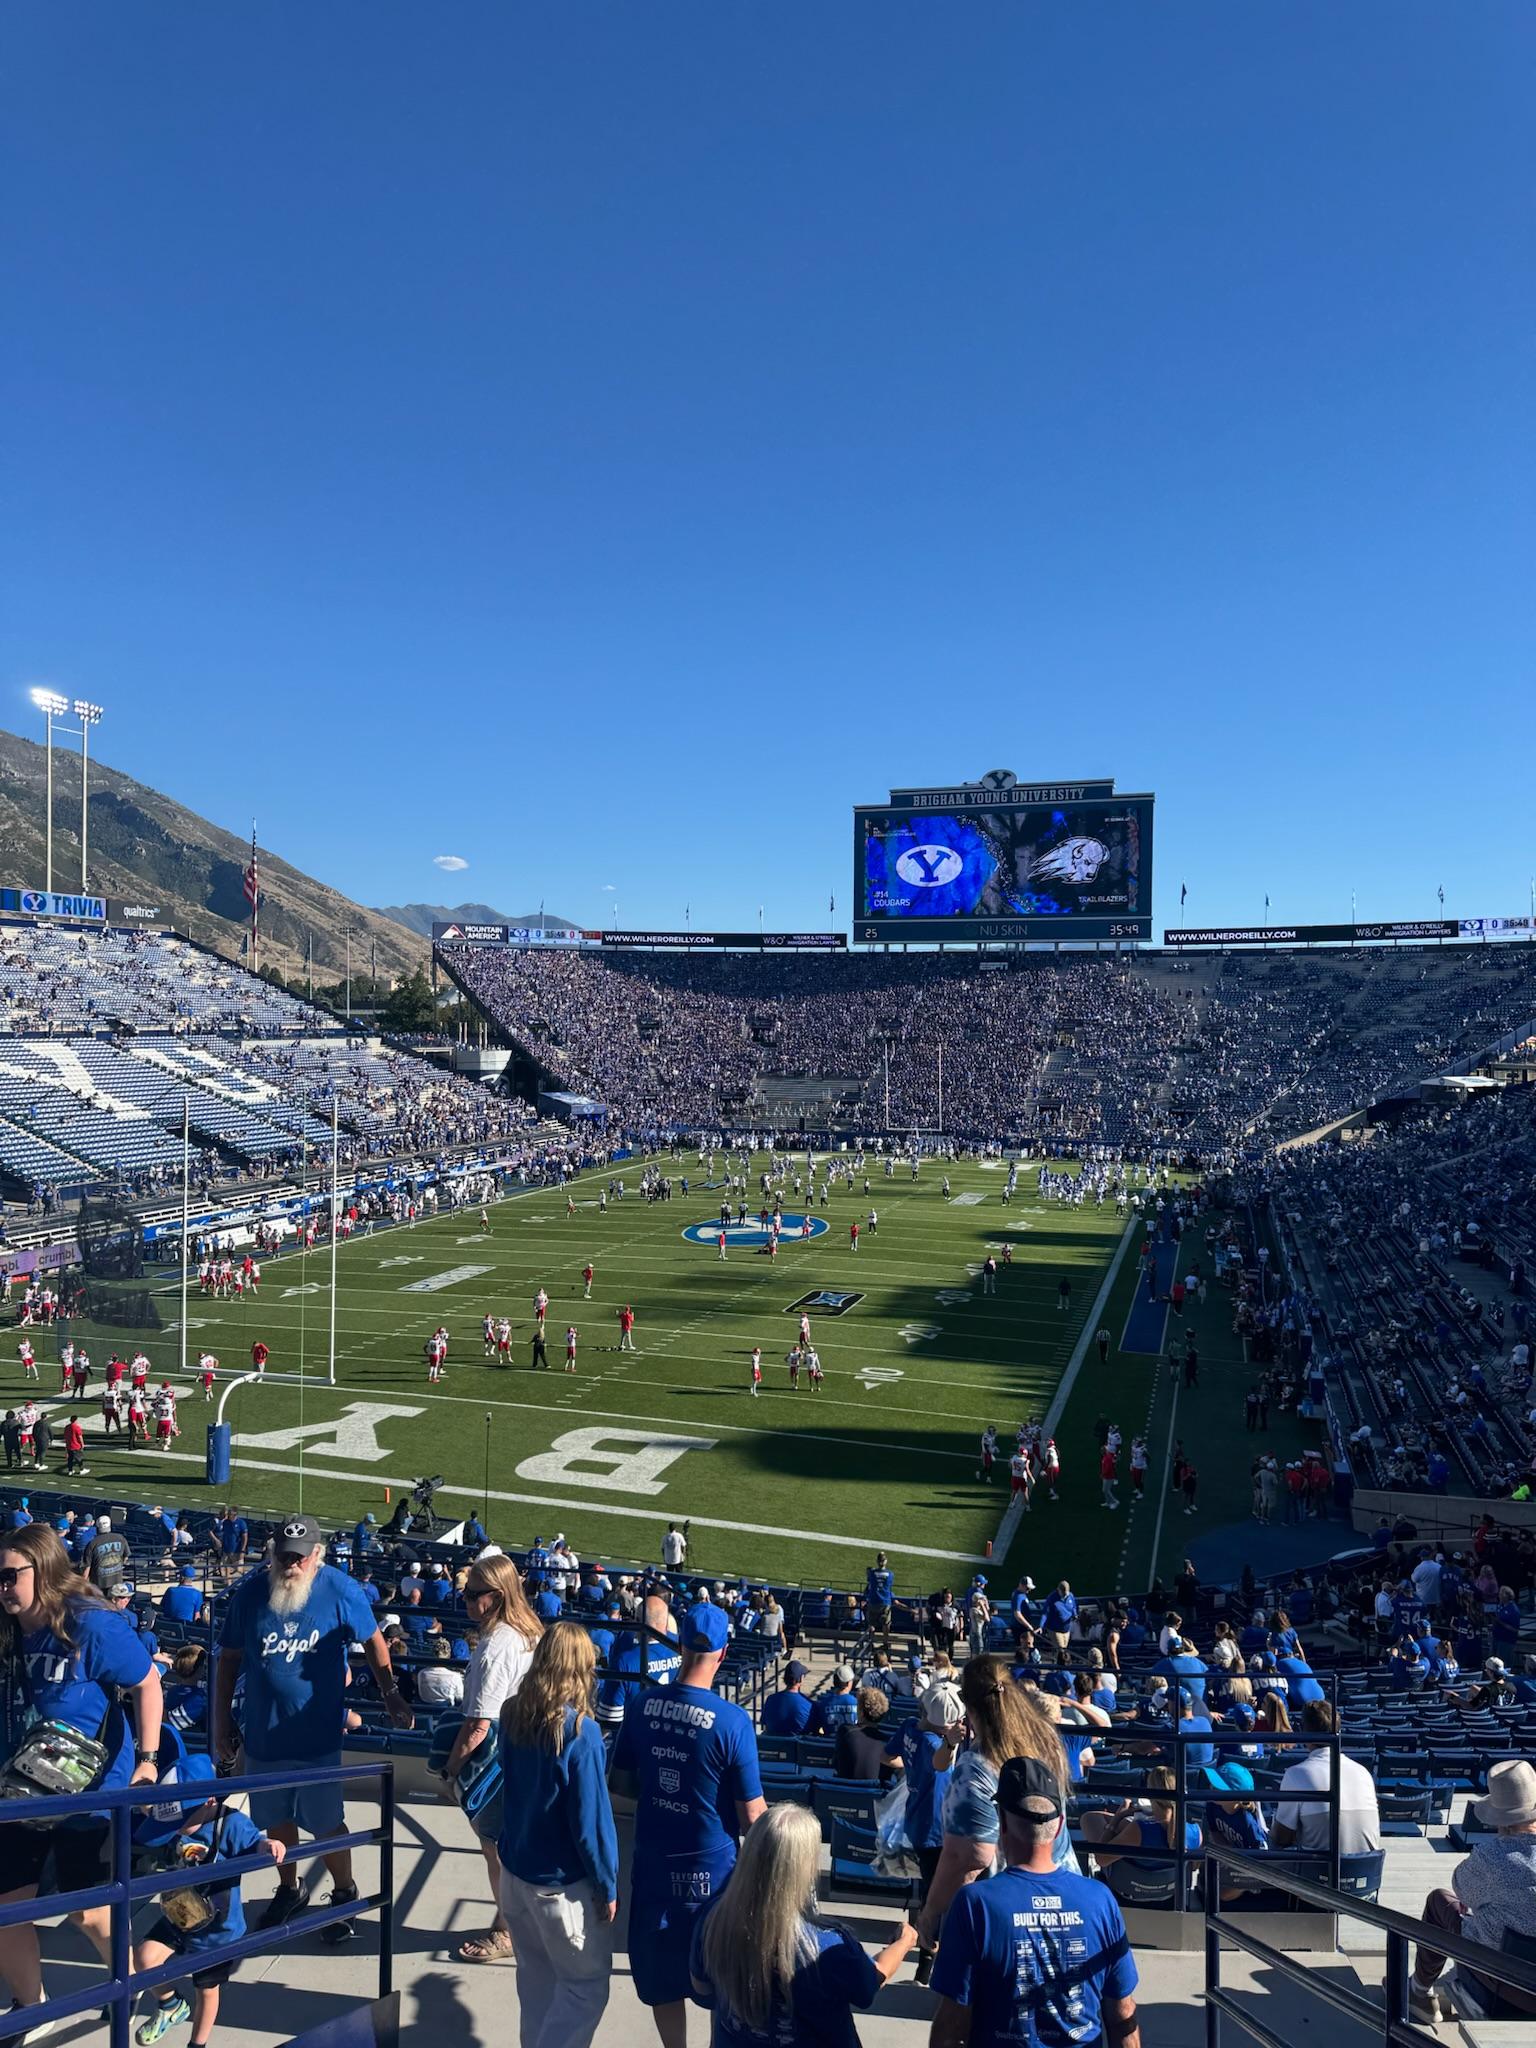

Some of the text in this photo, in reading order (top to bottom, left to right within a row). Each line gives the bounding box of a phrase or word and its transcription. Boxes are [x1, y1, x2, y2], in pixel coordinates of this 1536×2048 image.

[913, 788, 1085, 807] BRIGHAM YOUNG UNIVERSITY
[52, 894, 104, 918] TRIVIA
[874, 899, 911, 907] COUGARS
[123, 904, 155, 919] qualtrics
[465, 926, 503, 934] MOUNTAIN
[865, 928, 878, 938] 25
[980, 925, 1028, 937] NU SKIN
[1110, 924, 1139, 936] 35:49
[1168, 931, 1296, 941] WWW.WILNEROREILLY.COM
[1385, 929, 1425, 937] IMMIGRATION
[605, 934, 715, 943] WWW.WILNEROREILLY.COM
[39, 1248, 76, 1266] crumbl
[97, 1542, 122, 1554] BYU
[1401, 1610, 1421, 1625] 34
[262, 1629, 320, 1663] Loyal
[644, 1699, 716, 1730] GO COUGS
[825, 1704, 858, 1714] CLIFTON
[651, 1745, 688, 1762] aptive
[659, 1798, 689, 1814] PACS
[1013, 1911, 1084, 1928] BUILT FOR THIS.
